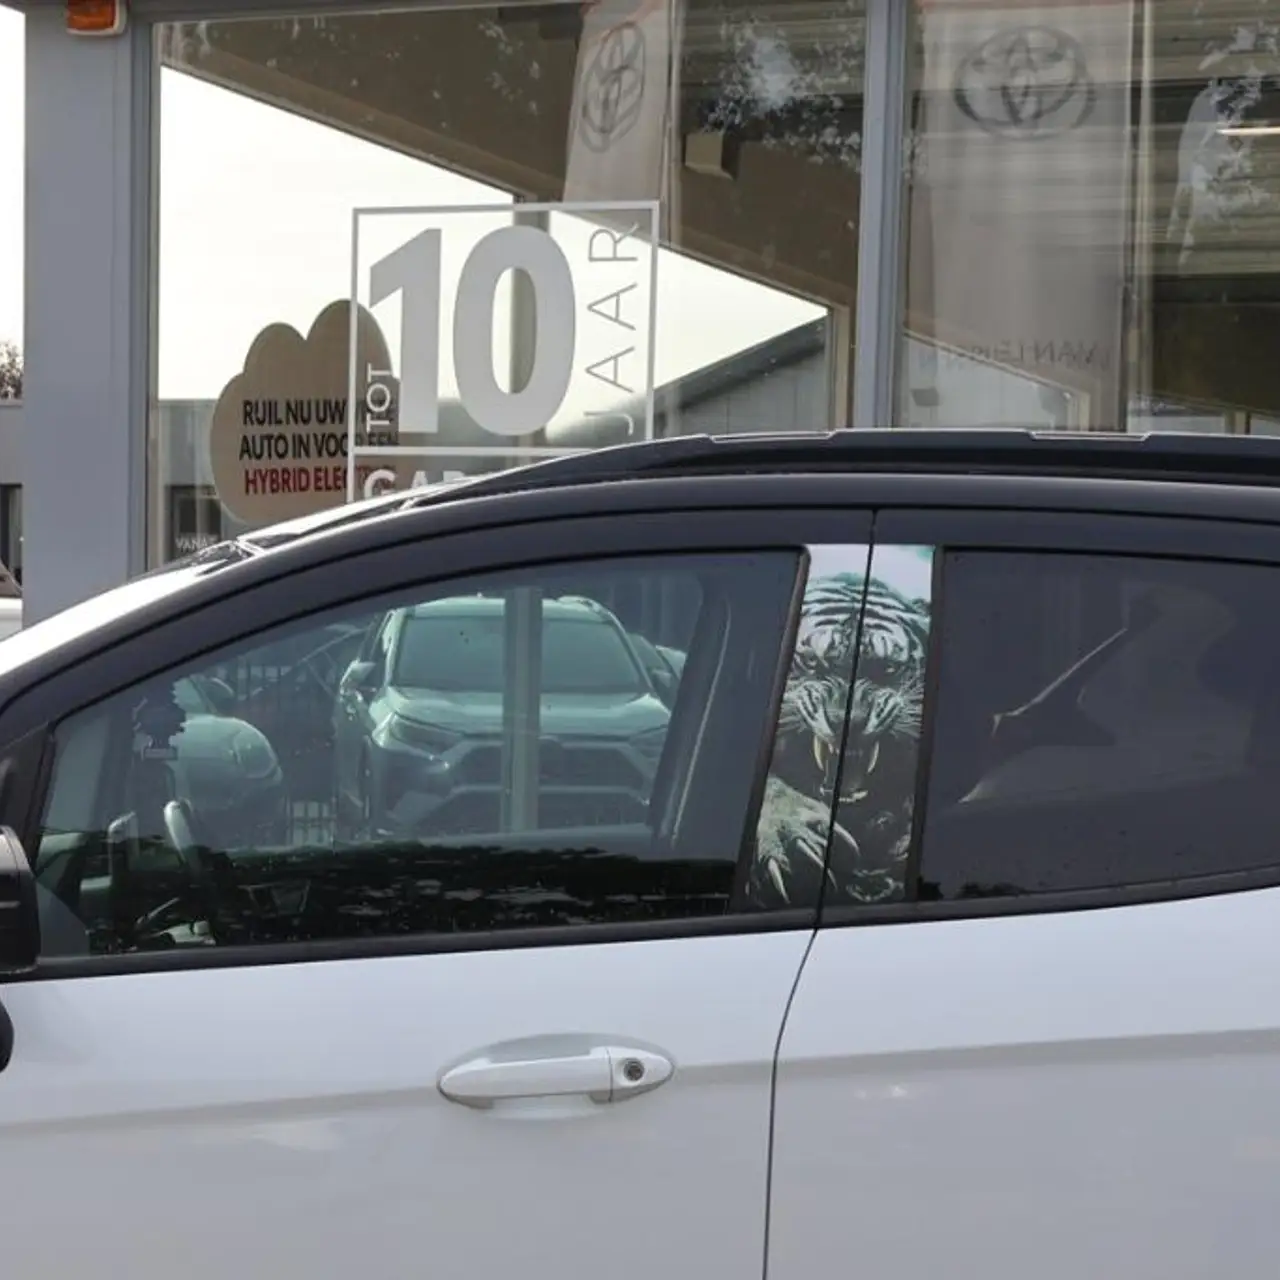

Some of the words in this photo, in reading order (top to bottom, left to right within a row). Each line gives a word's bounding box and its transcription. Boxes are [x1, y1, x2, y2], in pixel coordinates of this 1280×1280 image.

[369, 225, 576, 436] 10
[583, 223, 639, 436] JAAR
[243, 399, 283, 426] RUIL
[286, 399, 312, 426] NU
[315, 398, 348, 425] UW
[366, 362, 391, 433] TOT
[239, 433, 289, 460] AUTO
[292, 432, 311, 459] IN
[244, 467, 312, 496] HYBRID
